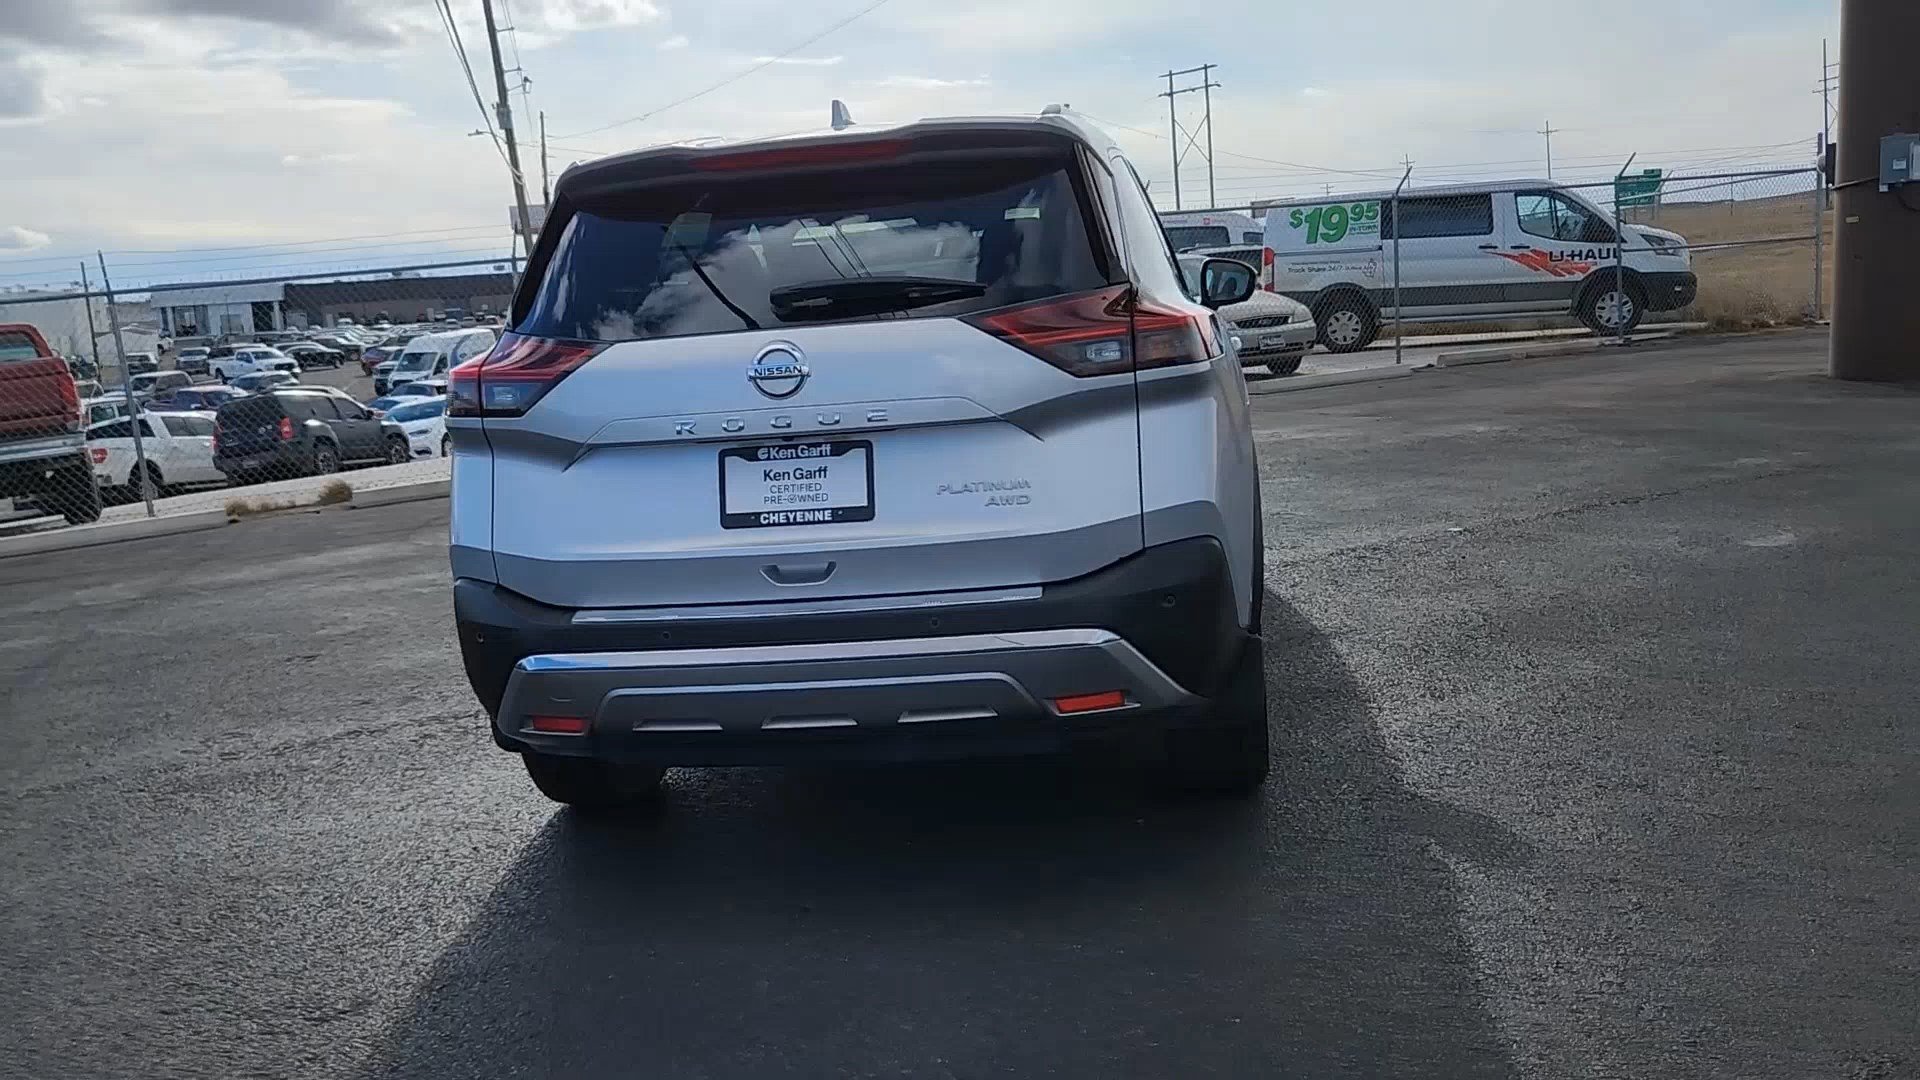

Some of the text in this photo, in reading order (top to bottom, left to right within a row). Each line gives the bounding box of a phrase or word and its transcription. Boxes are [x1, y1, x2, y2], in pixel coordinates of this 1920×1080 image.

[754, 365, 802, 376] NISSAN
[674, 408, 888, 435] ROGUE
[769, 444, 831, 460] Ken Garff
[763, 466, 828, 482] Ken Garff
[769, 483, 822, 494] CERTIFIED
[936, 478, 1031, 495] PLATINUM
[984, 495, 1032, 507] AWD
[760, 510, 833, 524] CHEYENNE
